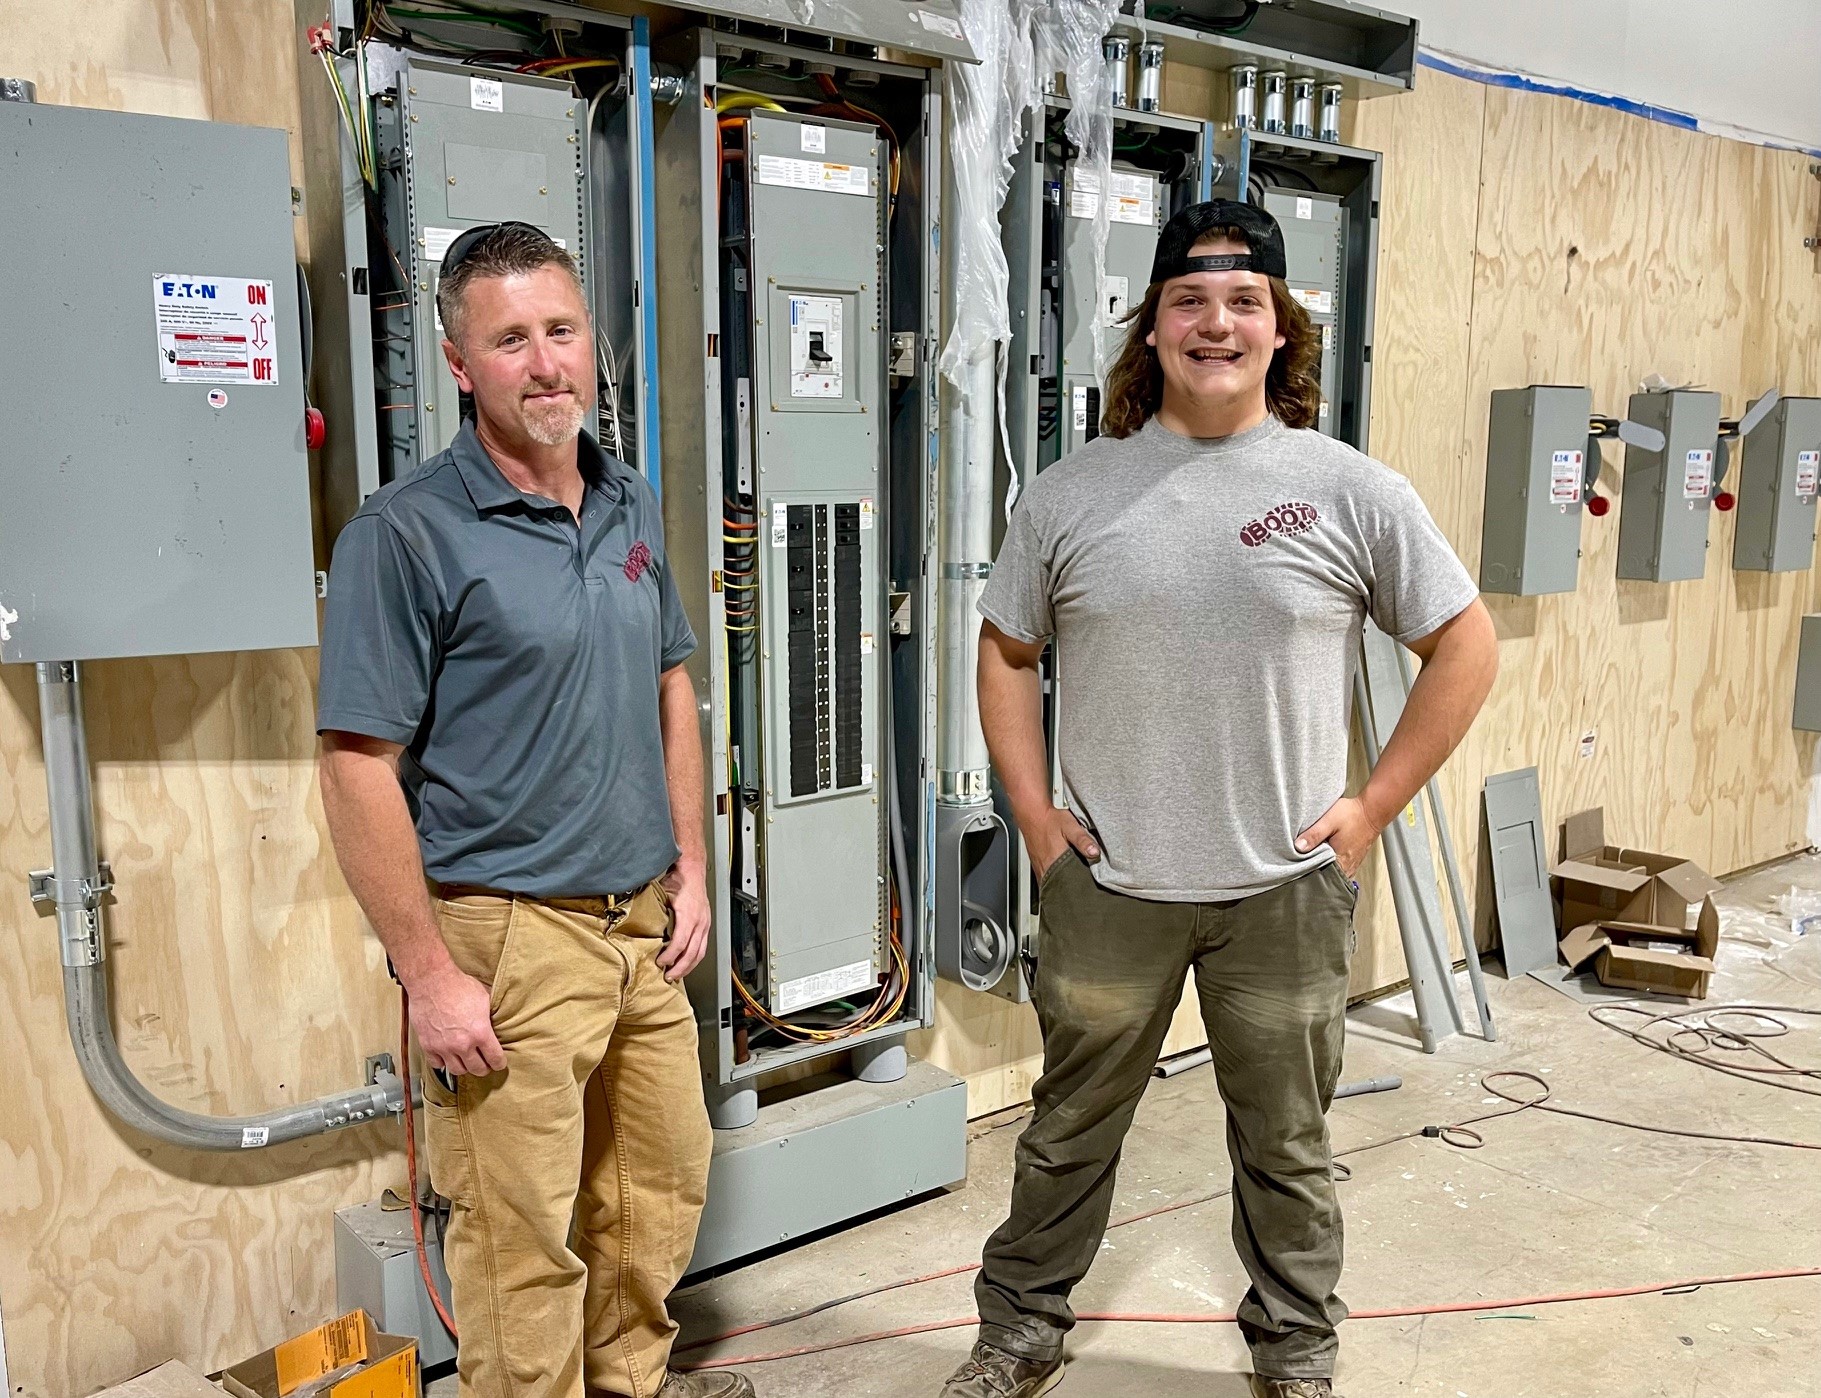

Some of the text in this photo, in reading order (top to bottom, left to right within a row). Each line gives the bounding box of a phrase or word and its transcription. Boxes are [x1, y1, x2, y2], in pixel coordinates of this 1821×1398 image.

[162, 282, 216, 299] EATON
[247, 284, 267, 305] ON
[253, 357, 272, 380] OFF
[1246, 506, 1309, 542] BOOT
